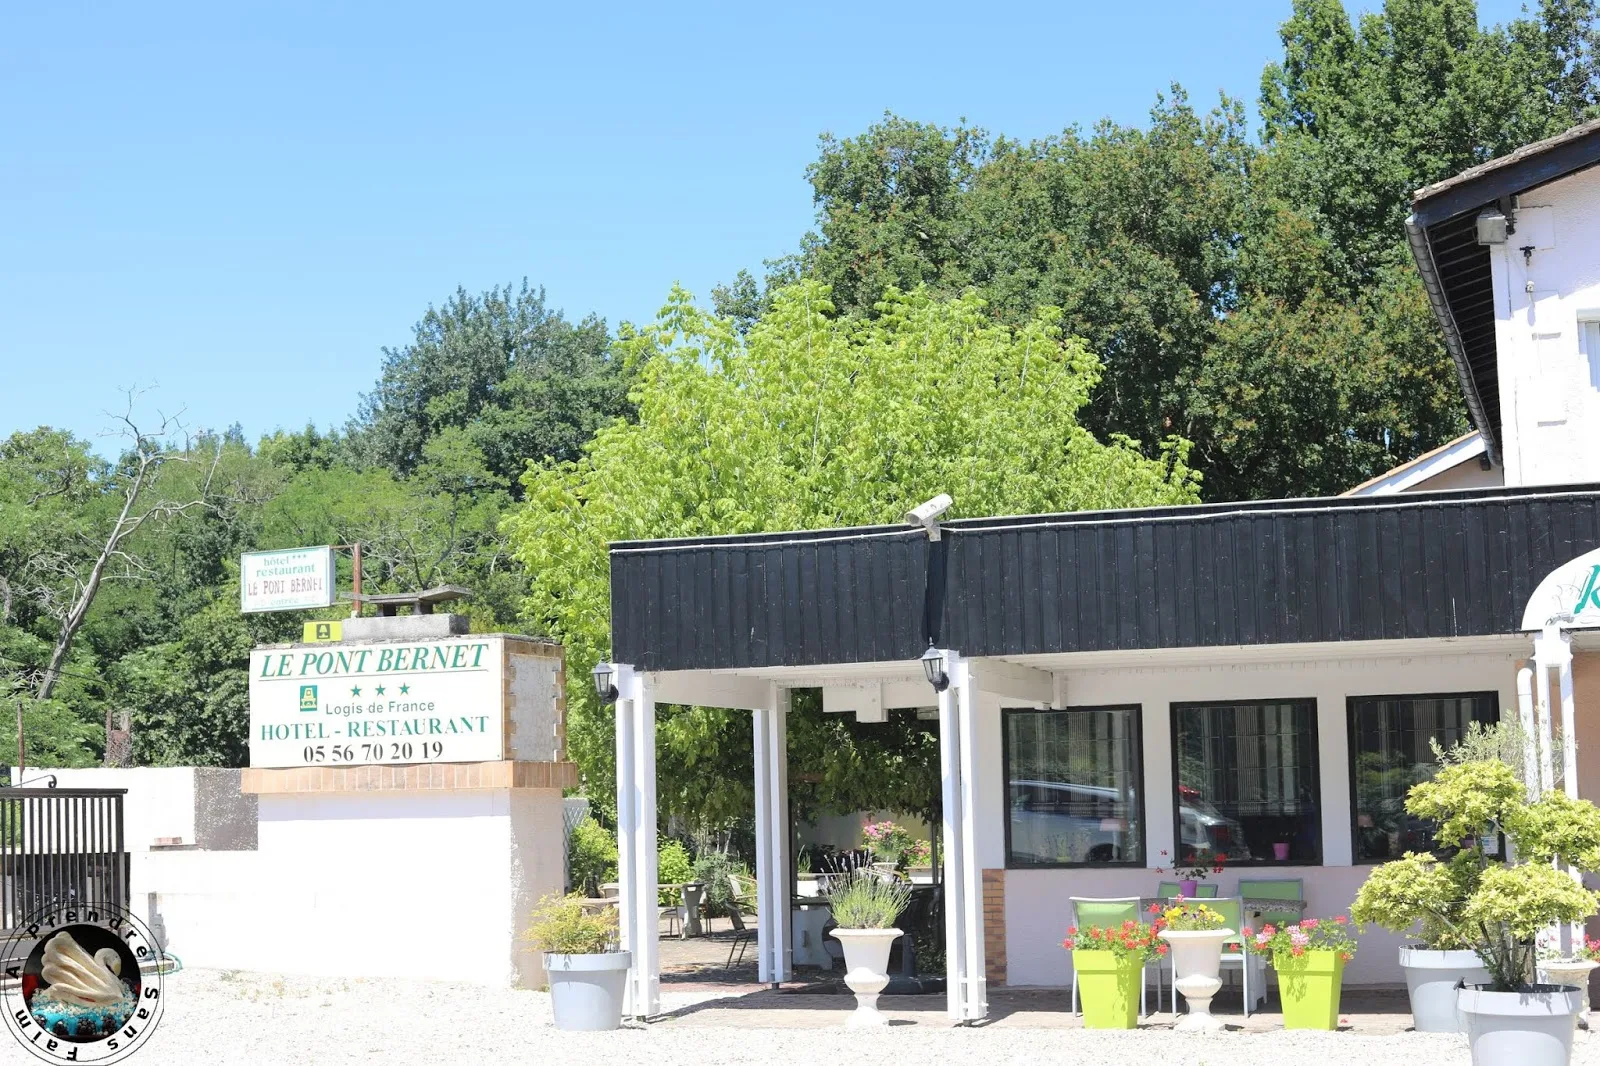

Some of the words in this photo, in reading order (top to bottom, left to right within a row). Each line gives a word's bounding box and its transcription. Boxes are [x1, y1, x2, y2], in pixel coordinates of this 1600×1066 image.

[263, 555, 290, 567] hôtel
[256, 563, 316, 578] restaurant
[248, 582, 258, 596] LE
[260, 653, 294, 678] LE
[298, 649, 373, 676] PONT
[376, 643, 490, 672] BERNET
[325, 702, 363, 718] Logis
[368, 702, 384, 714] de
[388, 701, 436, 713] France
[261, 722, 331, 741] HOTEL
[348, 715, 490, 738] RESTAURANT
[303, 745, 326, 763] 05
[331, 744, 354, 762] 56
[361, 743, 384, 761] 70
[390, 742, 413, 760] 20
[422, 741, 444, 759] 19
